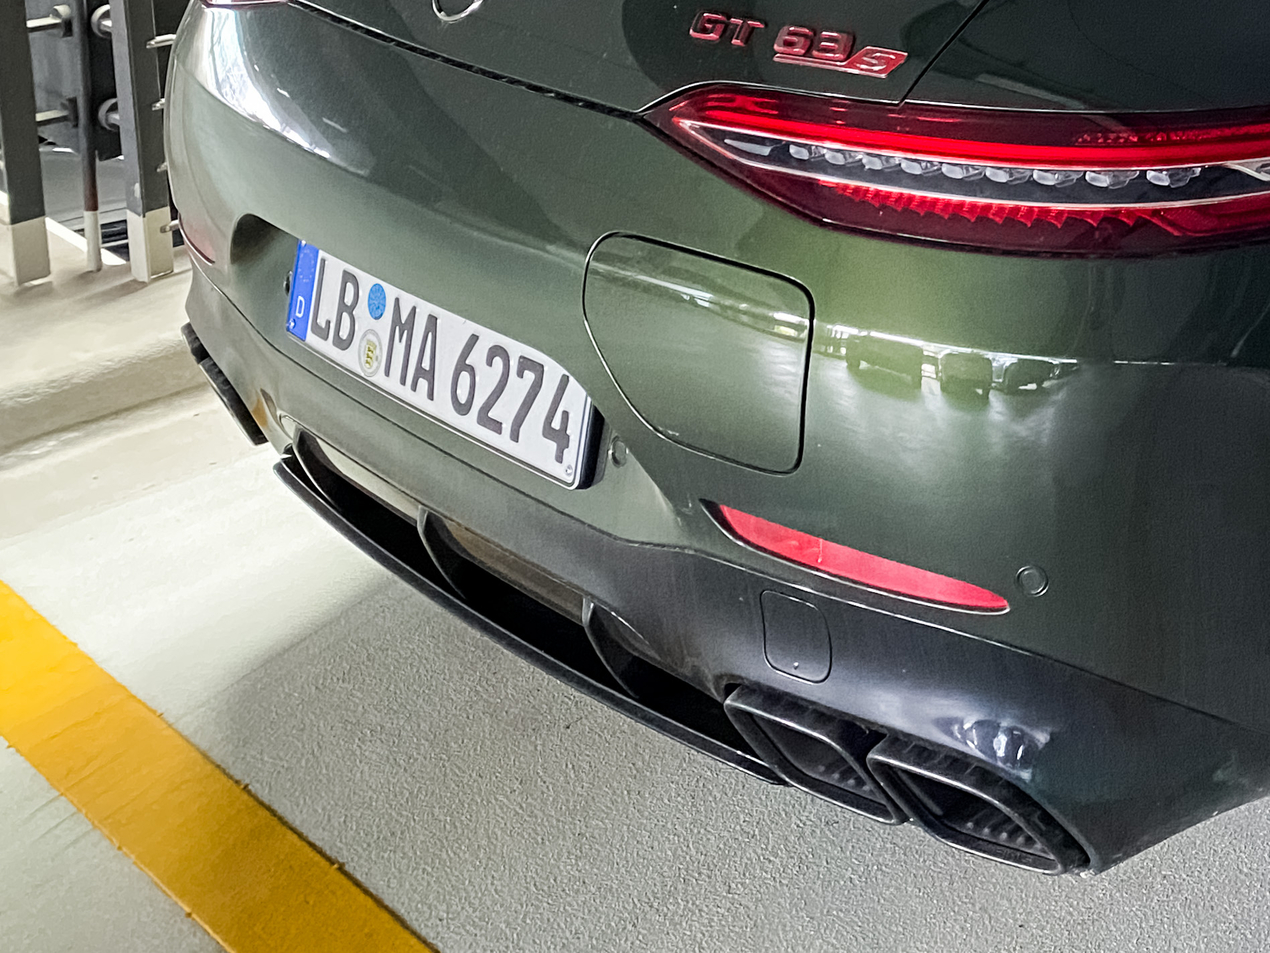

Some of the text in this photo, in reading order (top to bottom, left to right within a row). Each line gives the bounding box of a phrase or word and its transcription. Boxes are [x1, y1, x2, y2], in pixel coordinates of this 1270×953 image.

[689, 11, 766, 47] GT
[295, 295, 305, 318] D
[310, 257, 571, 464] LB MA 6274
